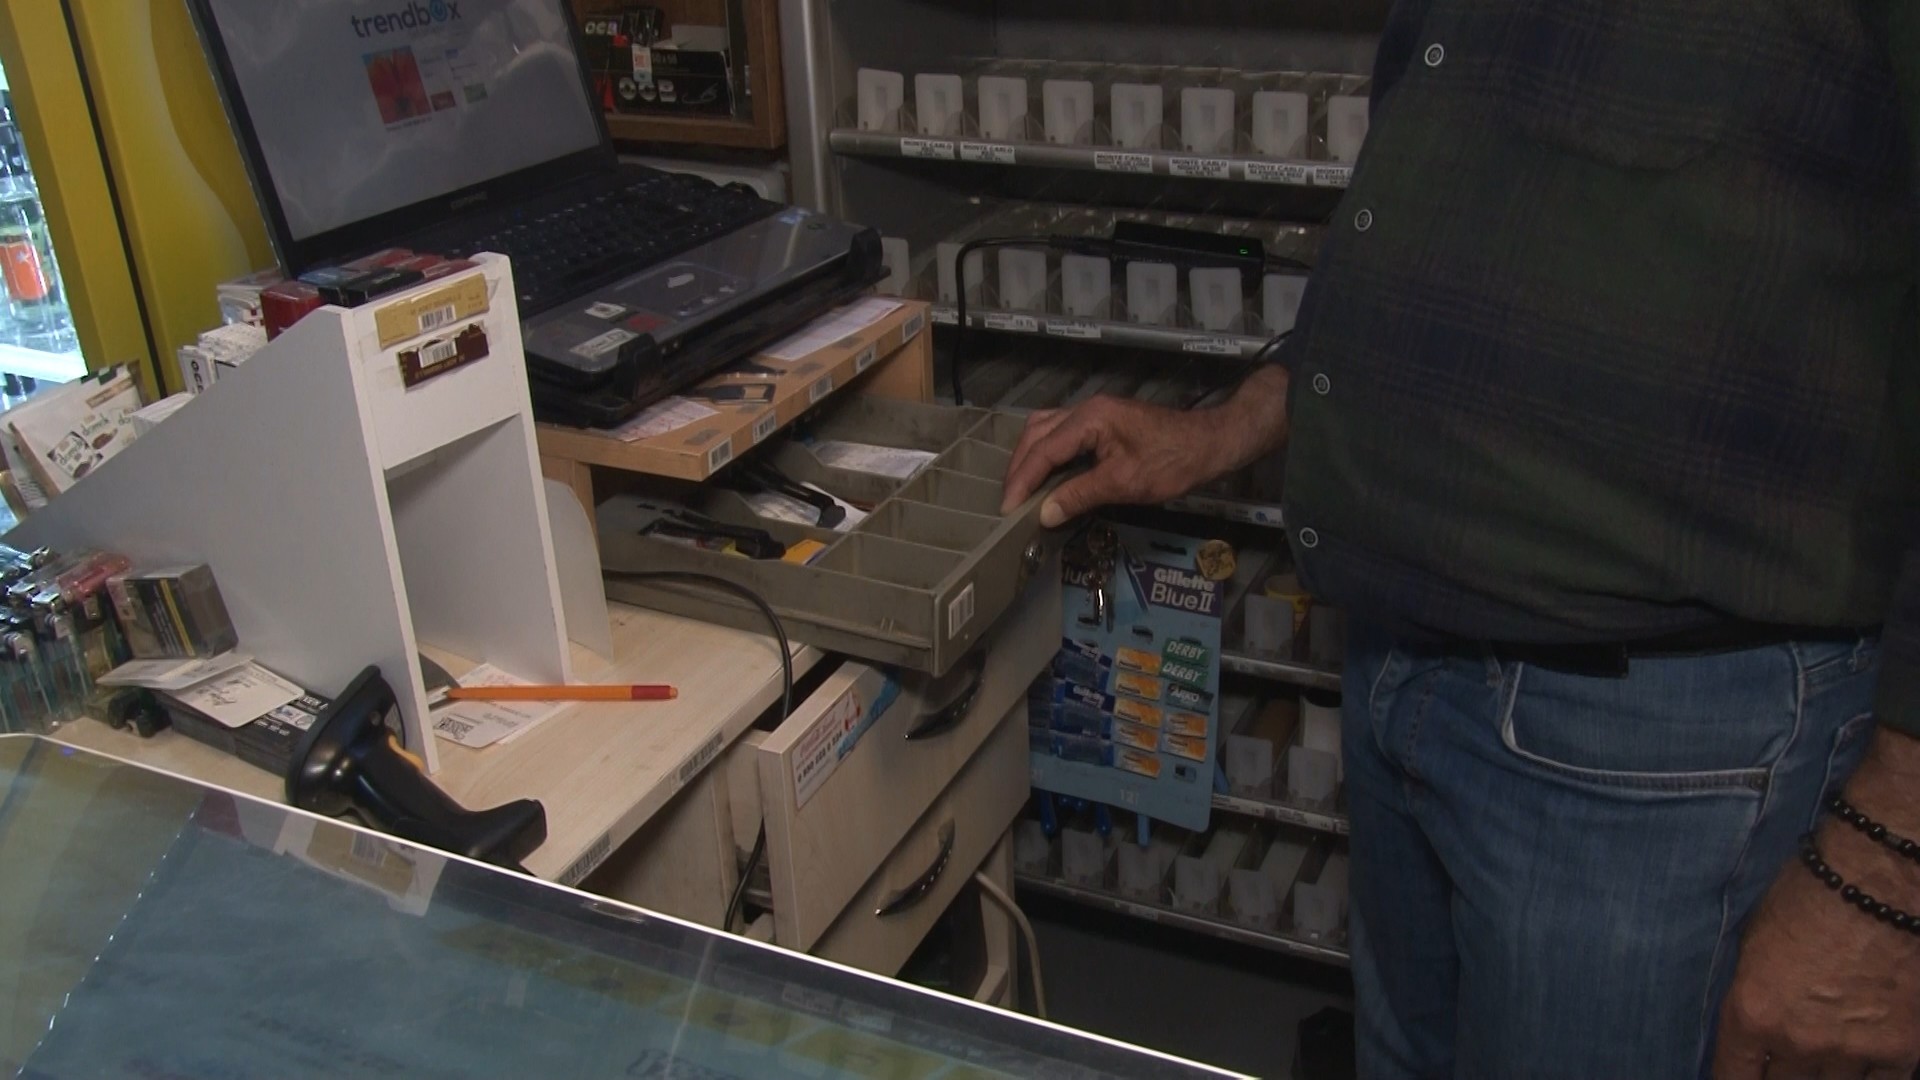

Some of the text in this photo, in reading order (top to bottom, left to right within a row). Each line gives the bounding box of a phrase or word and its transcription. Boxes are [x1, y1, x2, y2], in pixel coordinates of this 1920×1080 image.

[352, 0, 462, 38] trendbox
[903, 140, 953, 150] MONTE CARLO
[963, 143, 1013, 153] MONTE CARLO
[1097, 154, 1150, 163] MONTE CARLO
[1172, 159, 1227, 168] MONTE CARLO
[1248, 163, 1304, 173] MONTE CARLO
[1315, 168, 1344, 177] MONTE
[1153, 567, 1216, 592] Gillette
[1151, 583, 1199, 611] Blue
[1166, 641, 1206, 661] DERBY
[1162, 661, 1202, 683] DERBY
